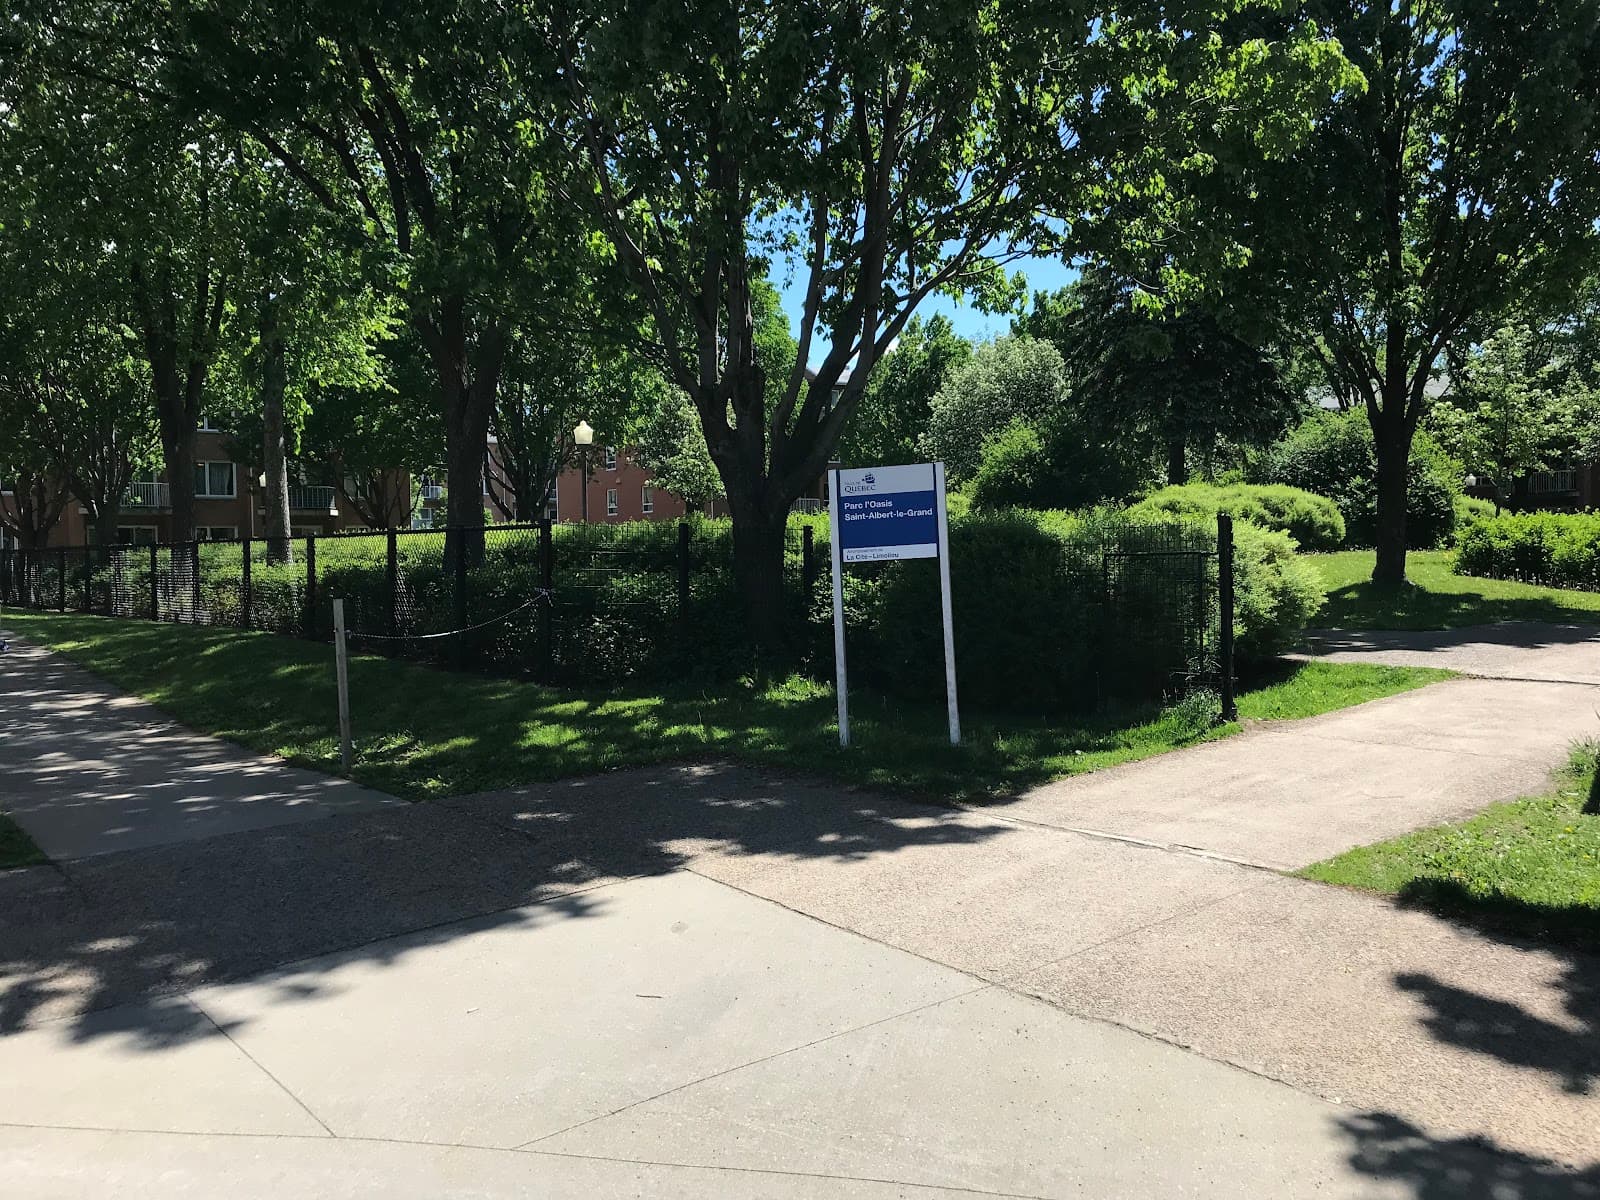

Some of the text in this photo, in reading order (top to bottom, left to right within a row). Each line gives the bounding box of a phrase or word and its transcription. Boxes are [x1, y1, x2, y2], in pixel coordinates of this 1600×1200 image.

[844, 500, 893, 510] Parc l'Oasis
[844, 508, 933, 521] Saint-Albert-le-Grand
